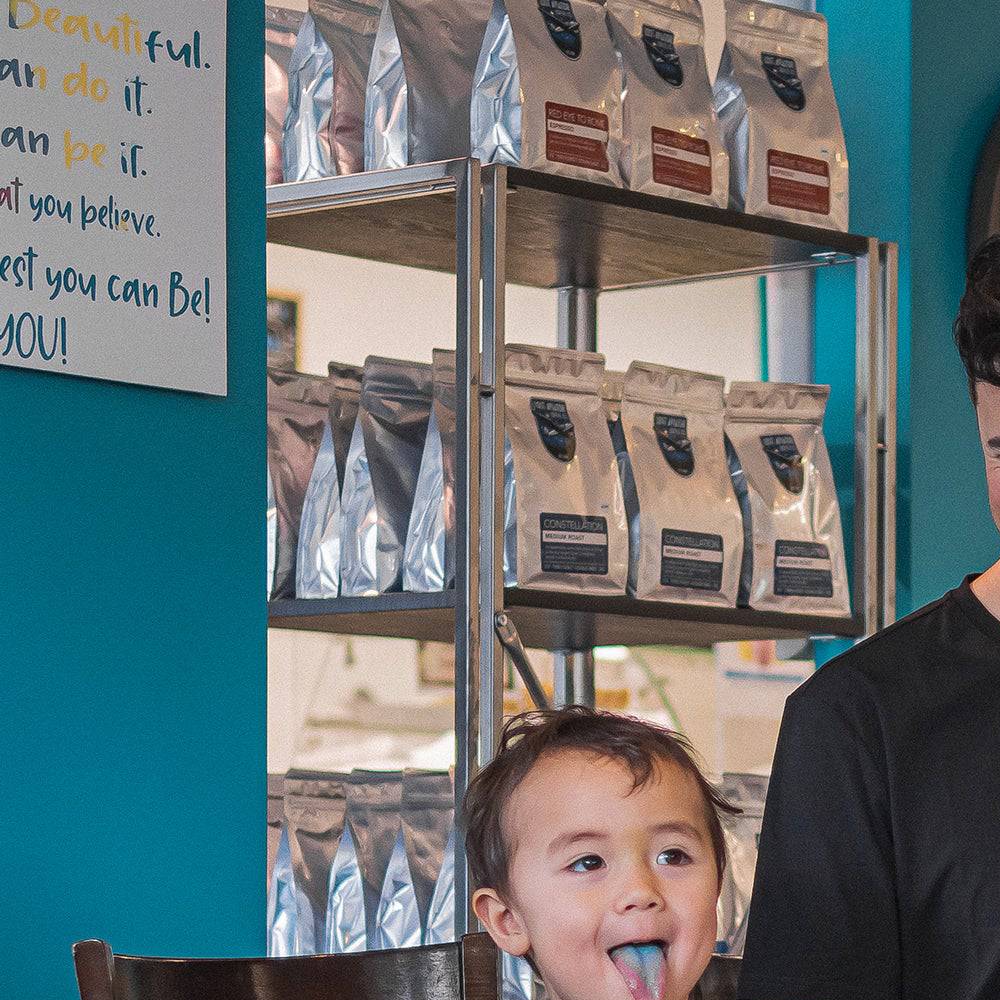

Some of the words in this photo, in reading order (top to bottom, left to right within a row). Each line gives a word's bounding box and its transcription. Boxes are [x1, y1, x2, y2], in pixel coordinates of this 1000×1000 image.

[63, 62, 108, 102] do
[63, 128, 107, 170] be
[29, 194, 72, 223] you
[81, 195, 161, 237] believe.
[46, 267, 96, 301] you
[107, 274, 158, 308] can
[169, 271, 210, 323] Be!
[543, 518, 604, 531] CONSTELLATION
[544, 532, 567, 540] MEDIUM
[568, 533, 585, 541] ROAST
